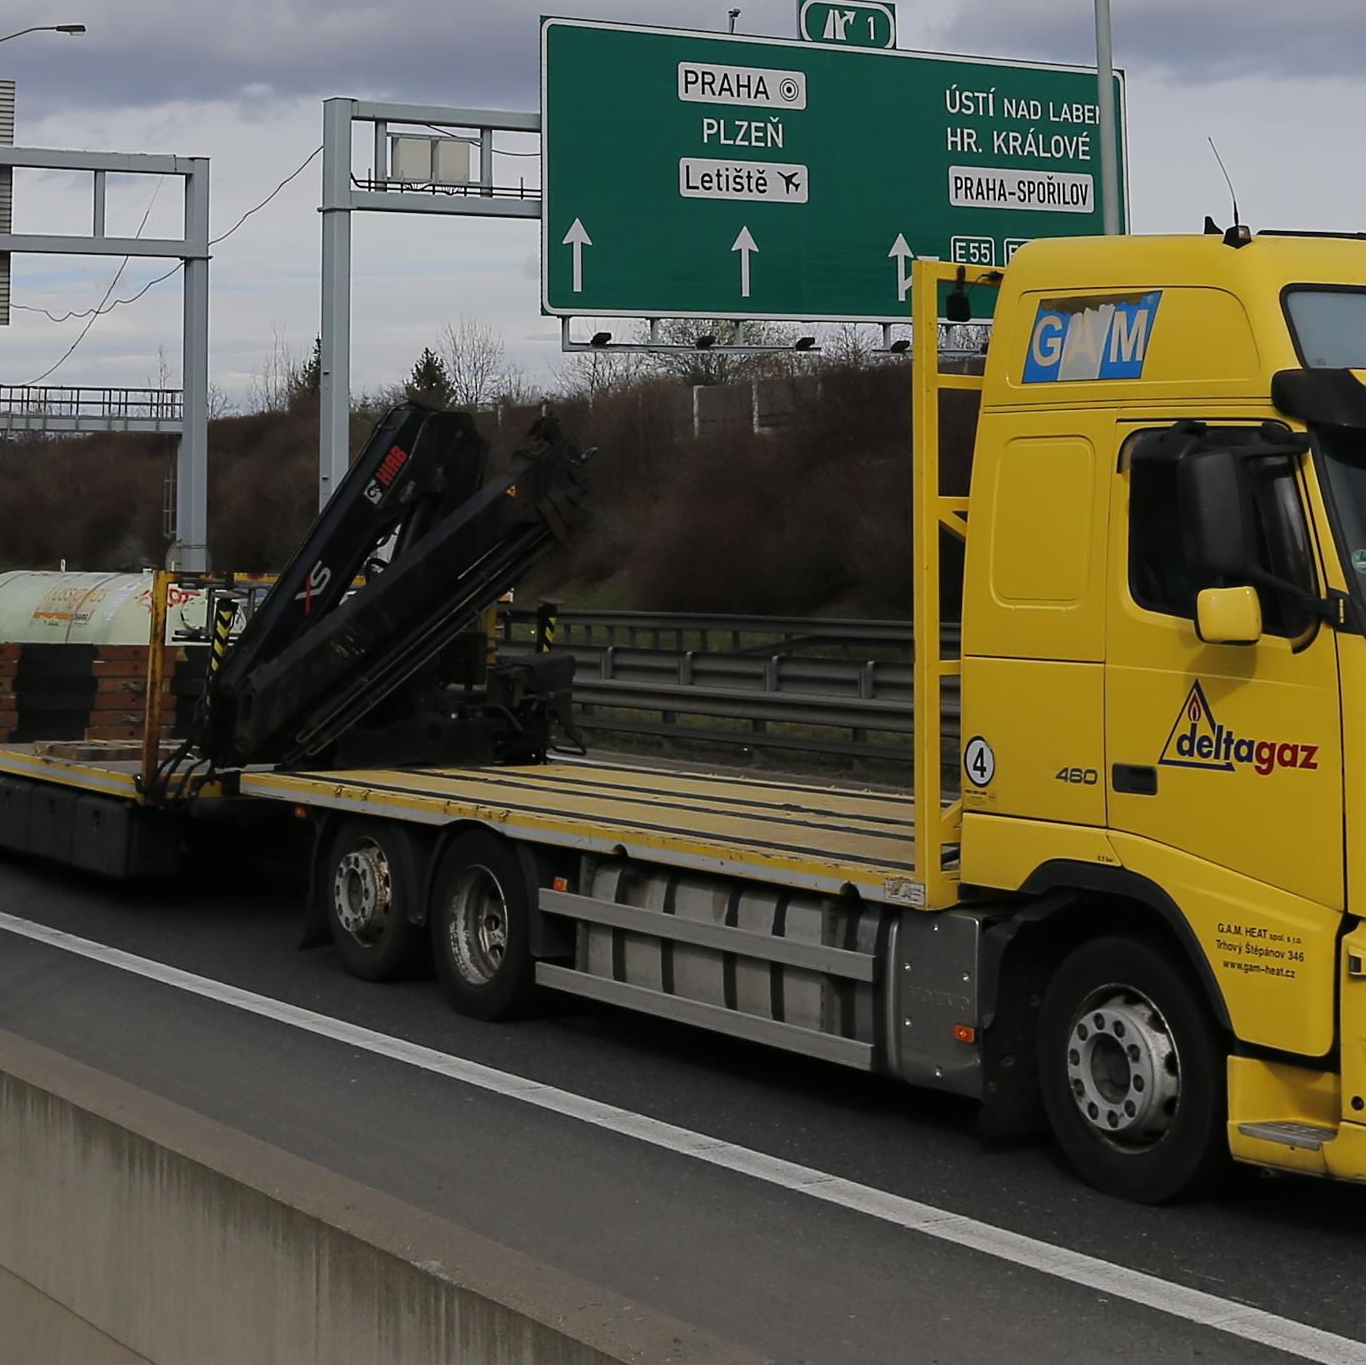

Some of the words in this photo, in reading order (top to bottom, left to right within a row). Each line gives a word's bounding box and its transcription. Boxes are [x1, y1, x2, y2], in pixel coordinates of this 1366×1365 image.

[867, 16, 875, 41] 1
[683, 69, 770, 101] PRAHA
[945, 84, 996, 117] ÚSTÍ
[1003, 98, 1042, 121] NAD
[1049, 102, 1100, 125] LABE
[702, 116, 783, 149] PLZEŇ
[946, 126, 983, 153] HR.
[993, 128, 1091, 161] KRÁLOVÉ
[685, 164, 768, 194] Letiště
[953, 175, 1089, 206] PRAHA-SPOŘILOV
[376, 445, 408, 486] HIAB
[973, 747, 987, 778] 4
[1176, 723, 1319, 776] deltagaz
[1055, 766, 1098, 785] 460
[1245, 927, 1268, 938] HEAT
[1215, 939, 1243, 954] Trhový
[1245, 942, 1285, 959] Štěpánov
[1288, 950, 1304, 962] 346
[1222, 960, 1296, 979] www.gam-heat.cz
